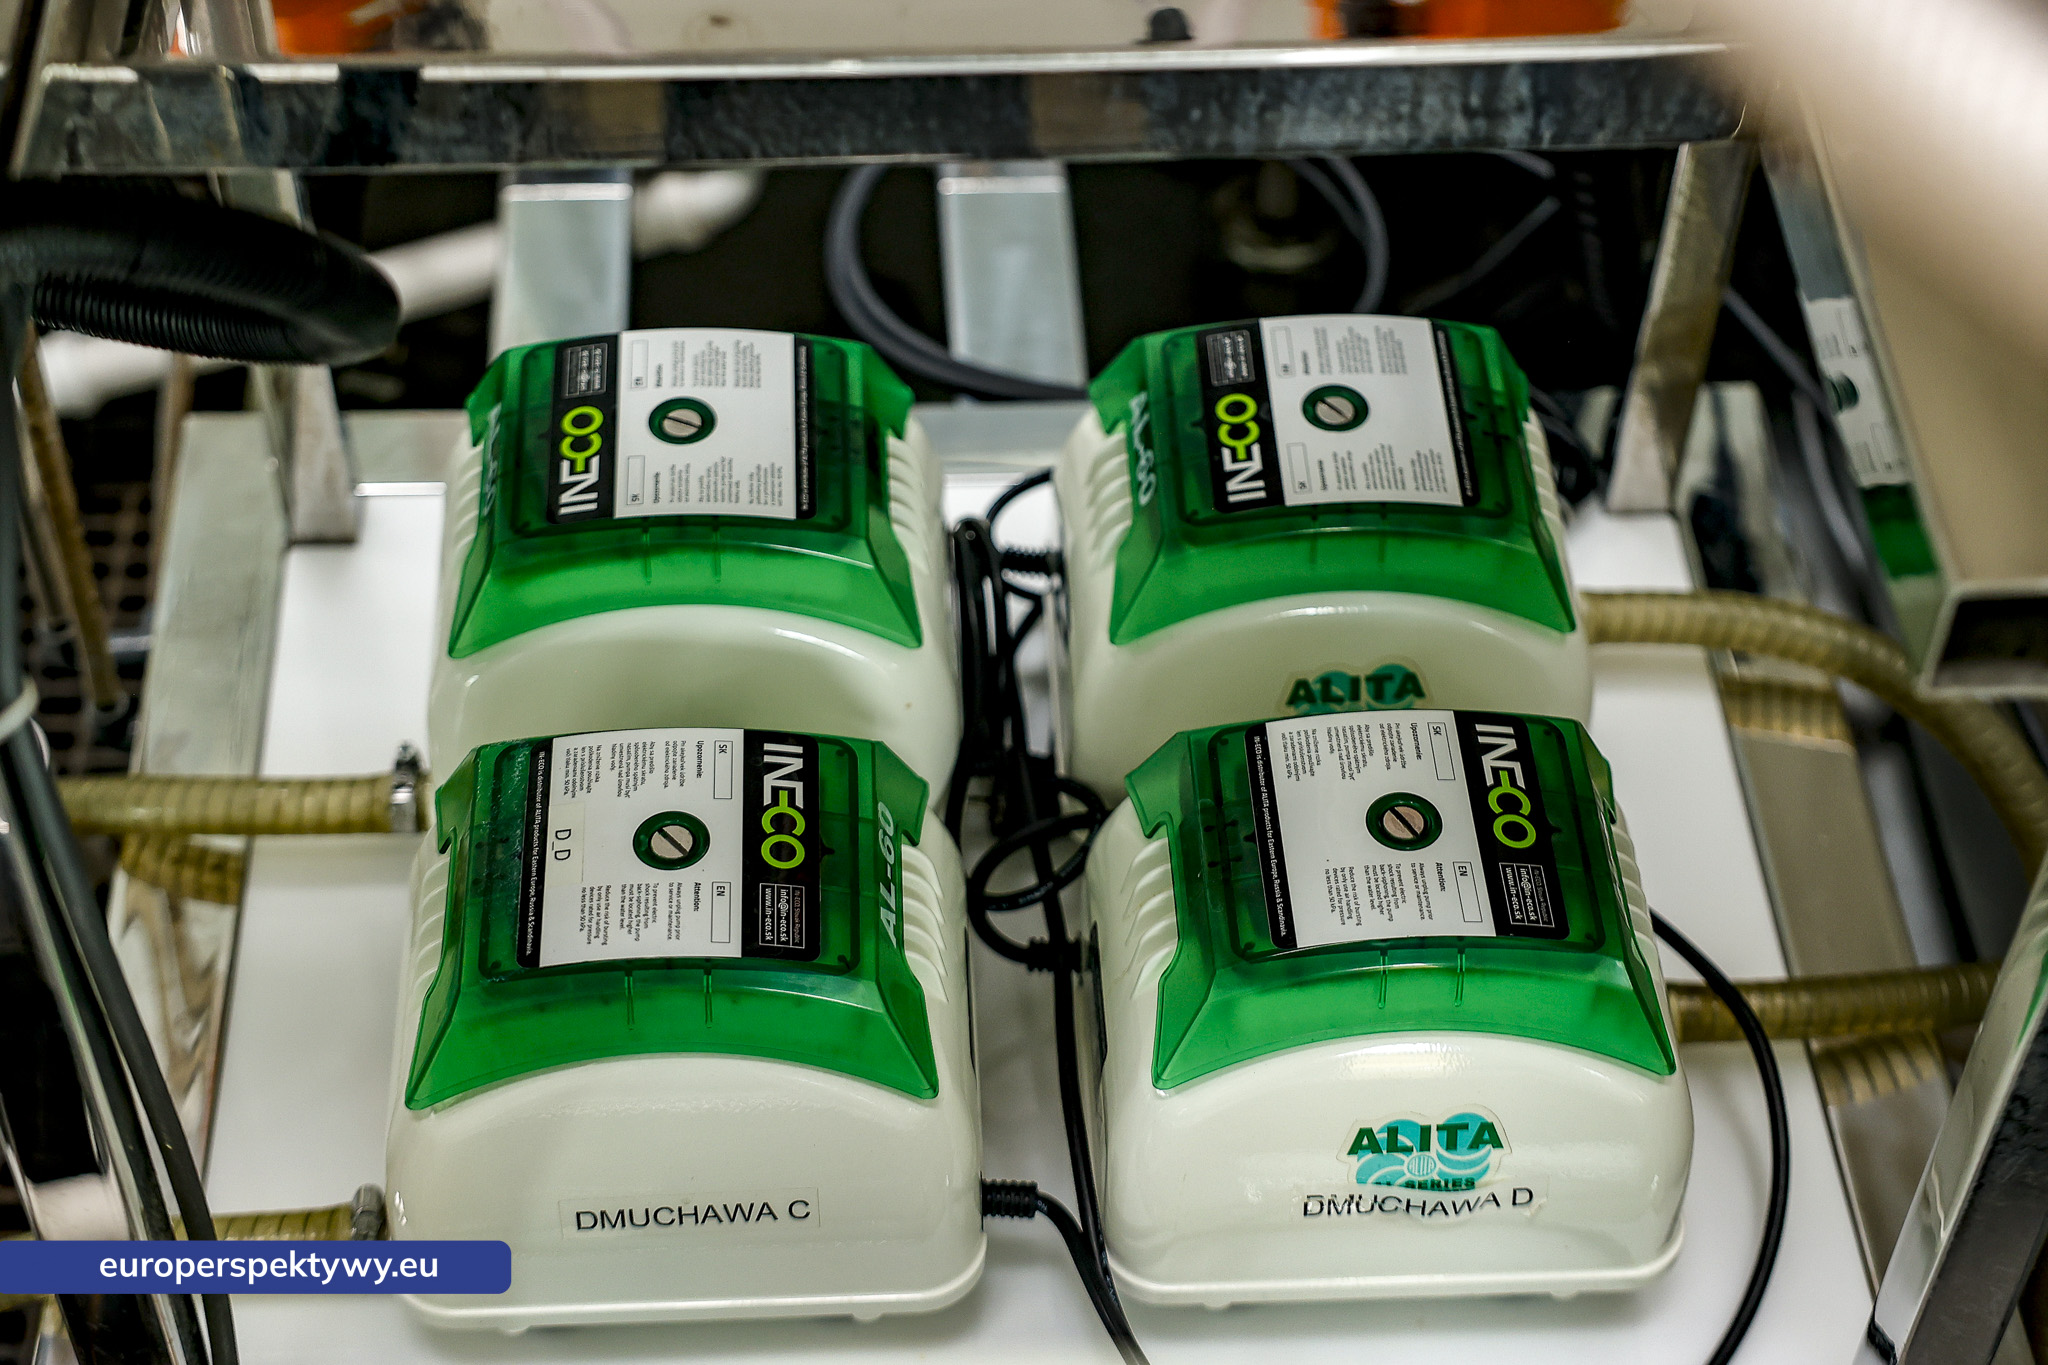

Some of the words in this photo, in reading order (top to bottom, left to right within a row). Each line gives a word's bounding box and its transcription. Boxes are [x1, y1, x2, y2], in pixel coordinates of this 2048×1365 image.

[1286, 672, 1426, 706] ALITA
[1432, 725, 1442, 736] SK
[718, 744, 727, 754] SK
[878, 801, 896, 949] AL-60
[1436, 862, 1446, 892] Attention:
[1458, 865, 1468, 876] EN
[716, 885, 725, 896] EN
[1505, 867, 1523, 920] www.in-eco.sk
[1520, 868, 1537, 921] info@in-eco.sk
[765, 888, 774, 941] www.in-eco.sk
[778, 889, 789, 942] info@in-eco.sk
[1347, 1122, 1504, 1155] ALITA
[1404, 1177, 1476, 1192] SERIES
[576, 1202, 778, 1230] DMUCHAWA
[788, 1200, 811, 1219] C
[1303, 1192, 1501, 1217] DMUCHAWA
[1512, 1187, 1534, 1206] D
